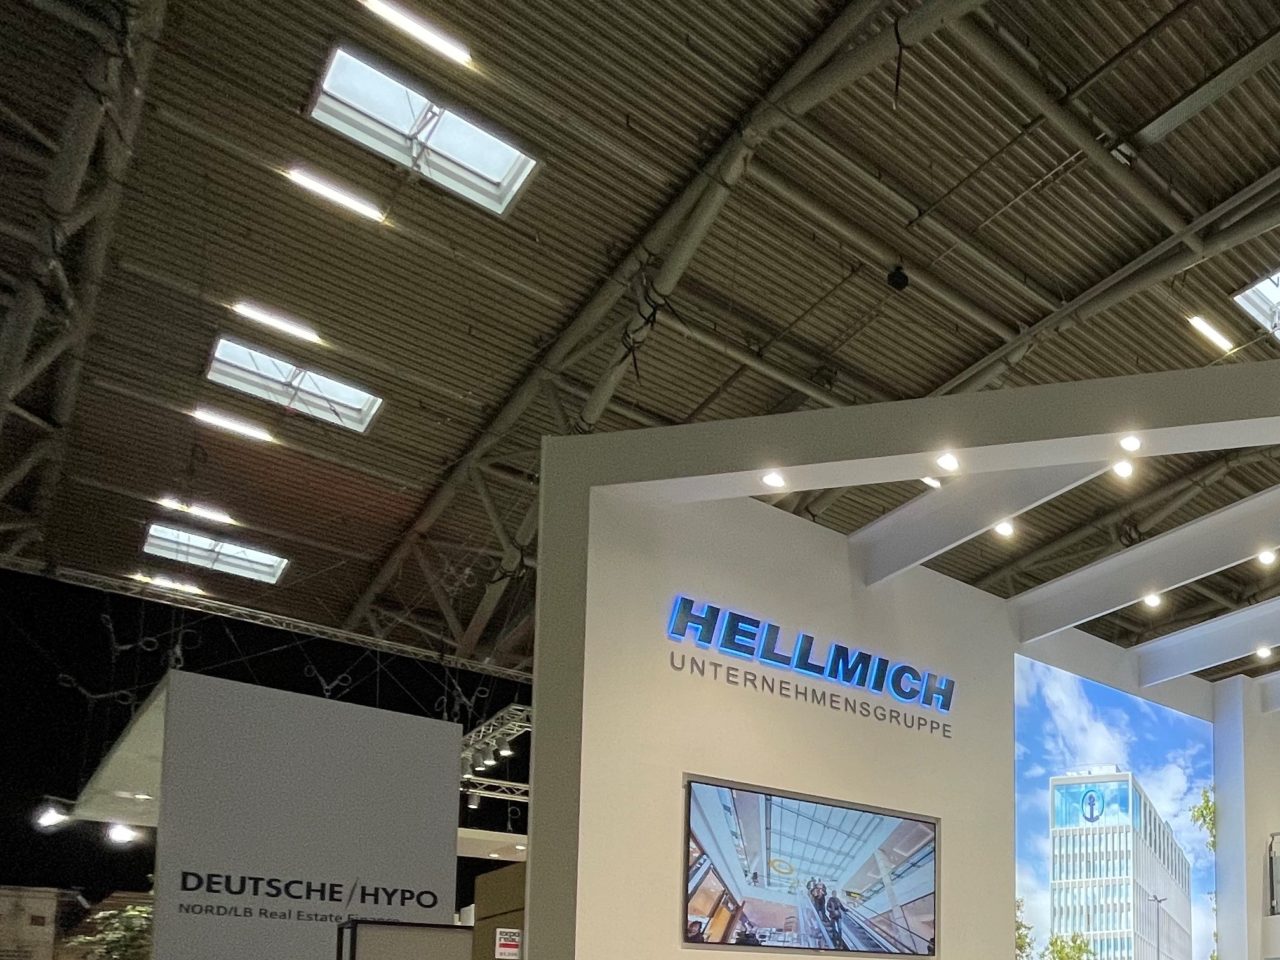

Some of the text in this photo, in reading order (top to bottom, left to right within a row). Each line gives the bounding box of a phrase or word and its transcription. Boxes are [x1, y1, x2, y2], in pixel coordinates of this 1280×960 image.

[669, 595, 956, 712] HELLMICH
[670, 651, 953, 739] UNTERNEHMENSGRUPPE
[178, 903, 254, 918] NORD/LB
[258, 908, 292, 920] Real
[296, 910, 344, 922] Estate
